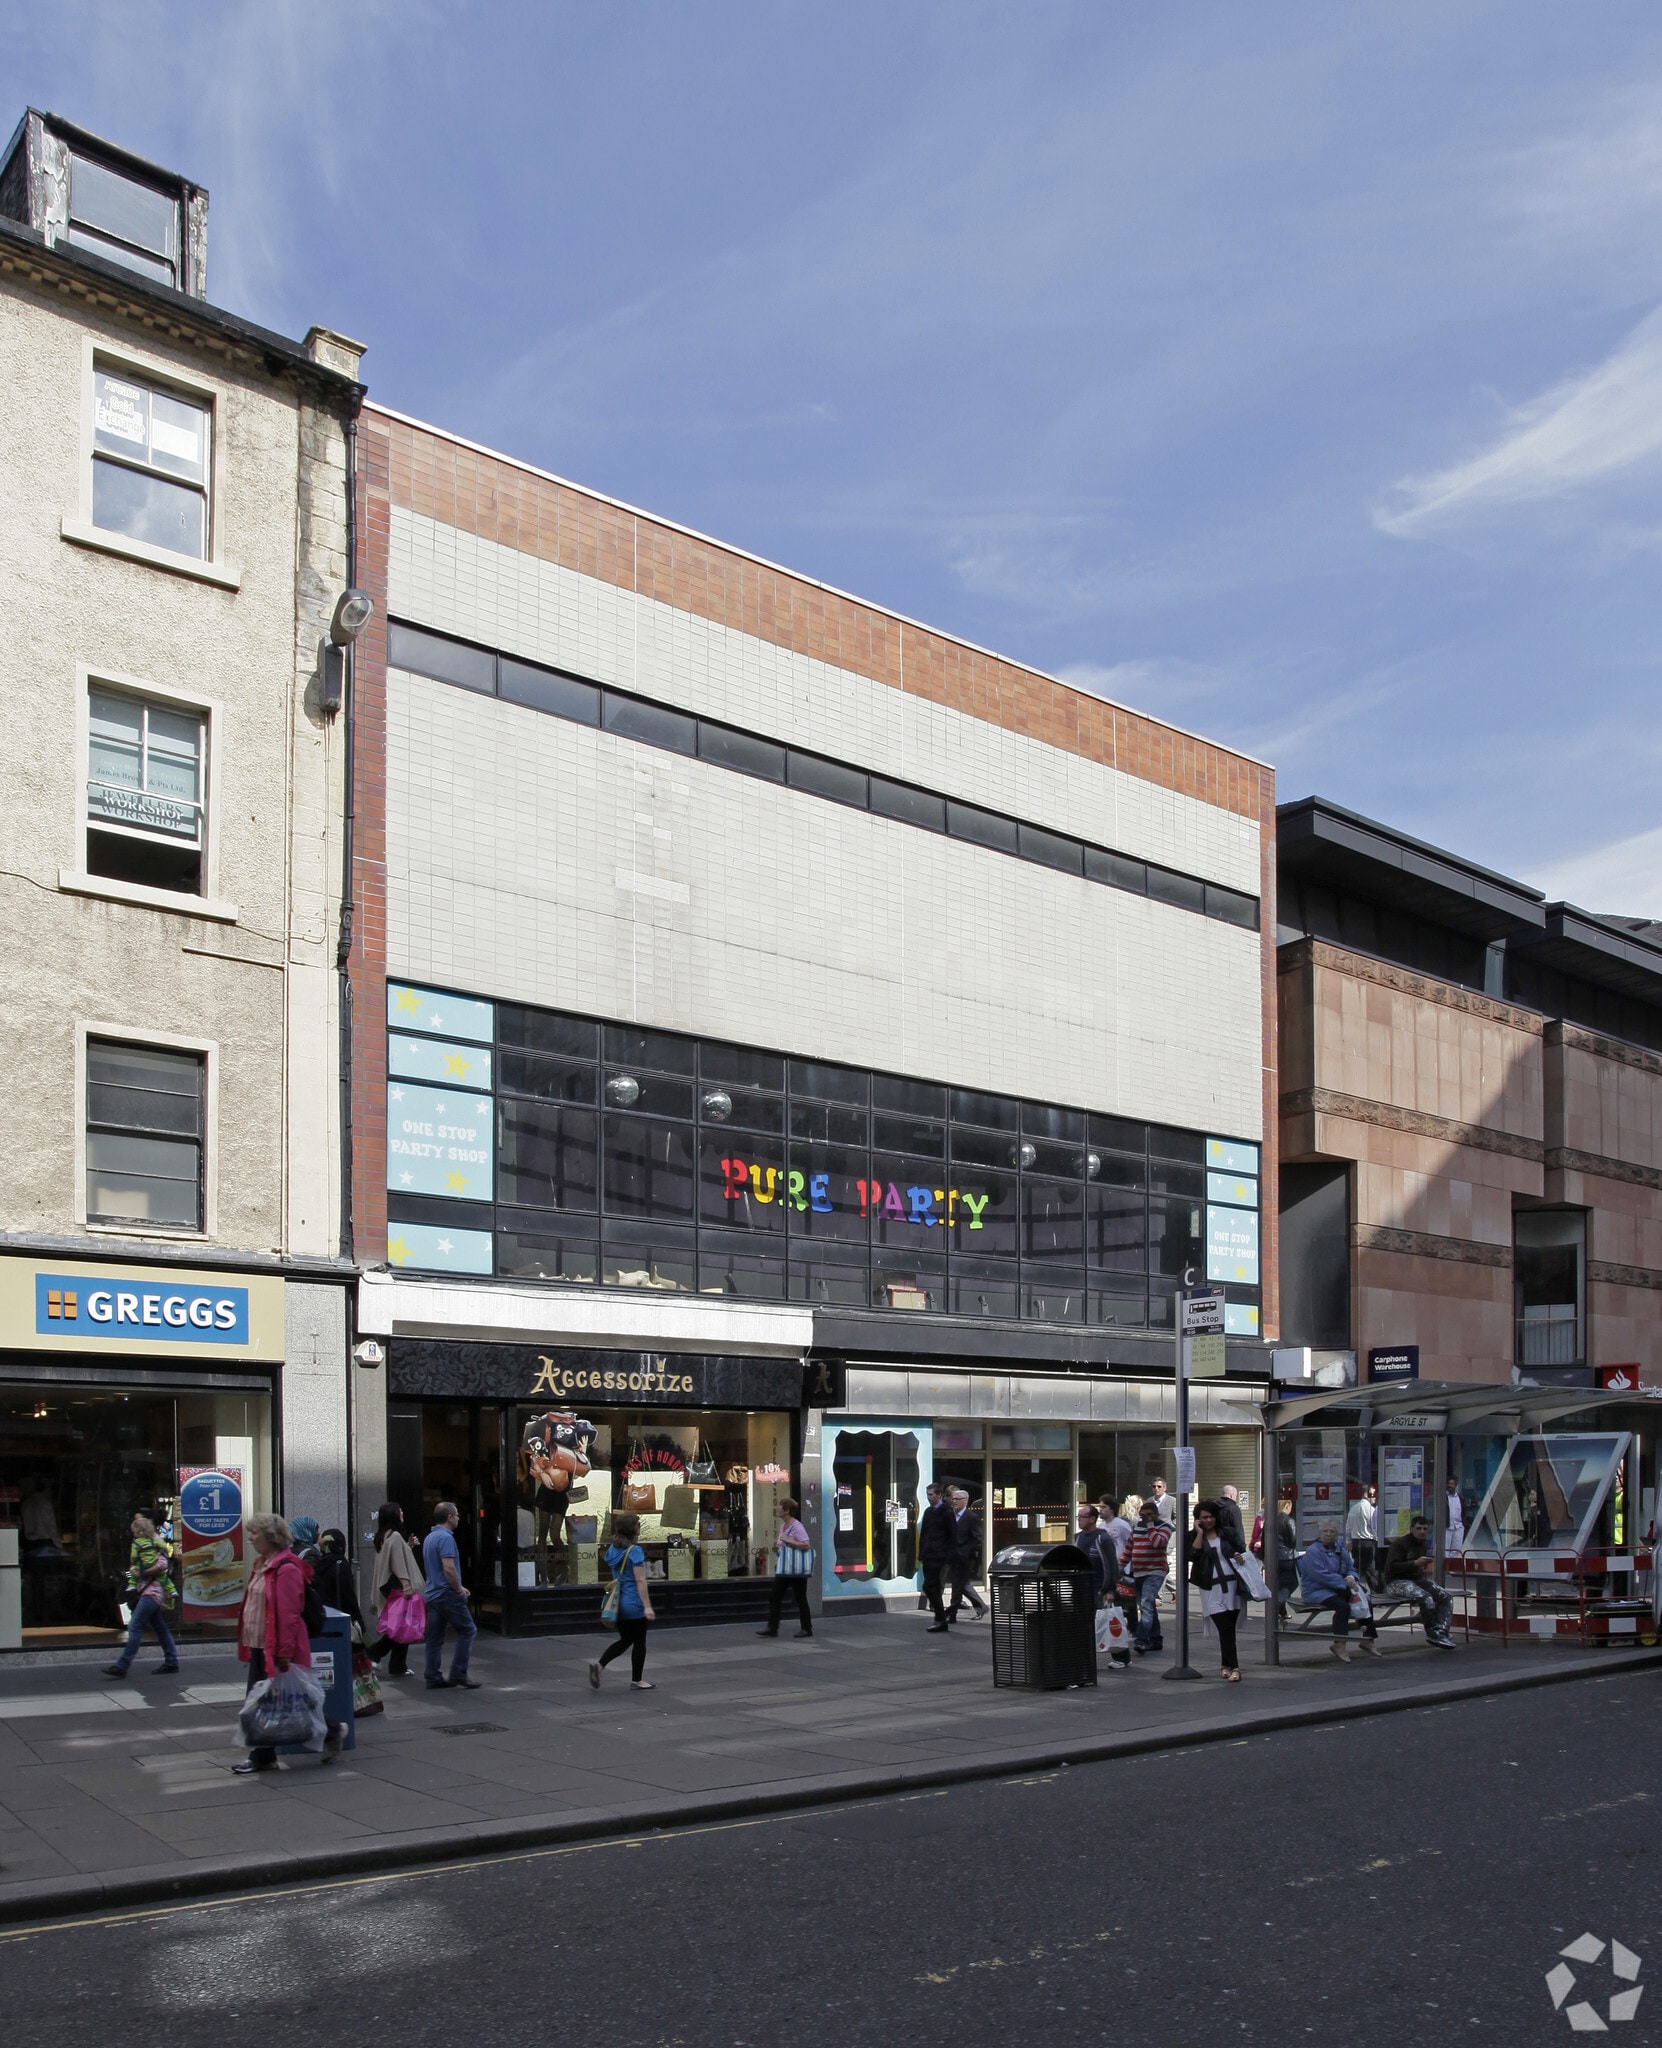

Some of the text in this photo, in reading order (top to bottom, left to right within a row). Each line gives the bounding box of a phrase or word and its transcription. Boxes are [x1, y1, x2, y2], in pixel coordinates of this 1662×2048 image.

[99, 409, 146, 436] Exchange
[100, 788, 184, 813] JEWELERS
[104, 796, 184, 821] WORKSHOP
[402, 1120, 477, 1142] ONE STOP
[390, 1139, 488, 1164] PARTY SHOP
[720, 1158, 989, 1230] PURE PARTY
[1214, 1231, 1250, 1244] ONE STOP
[1209, 1244, 1256, 1259] PARTY SHOP
[1184, 1268, 1195, 1286] C
[88, 1292, 236, 1329] GREGGS
[1186, 1315, 1219, 1325] Bus Stop
[1374, 1355, 1408, 1364] Carphone
[530, 1355, 694, 1396] Accessorize
[1389, 1417, 1428, 1426] ARGYLE ST
[642, 1449, 653, 1463] OF
[763, 1463, 781, 1473] 10%
[199, 1488, 220, 1510] £1
